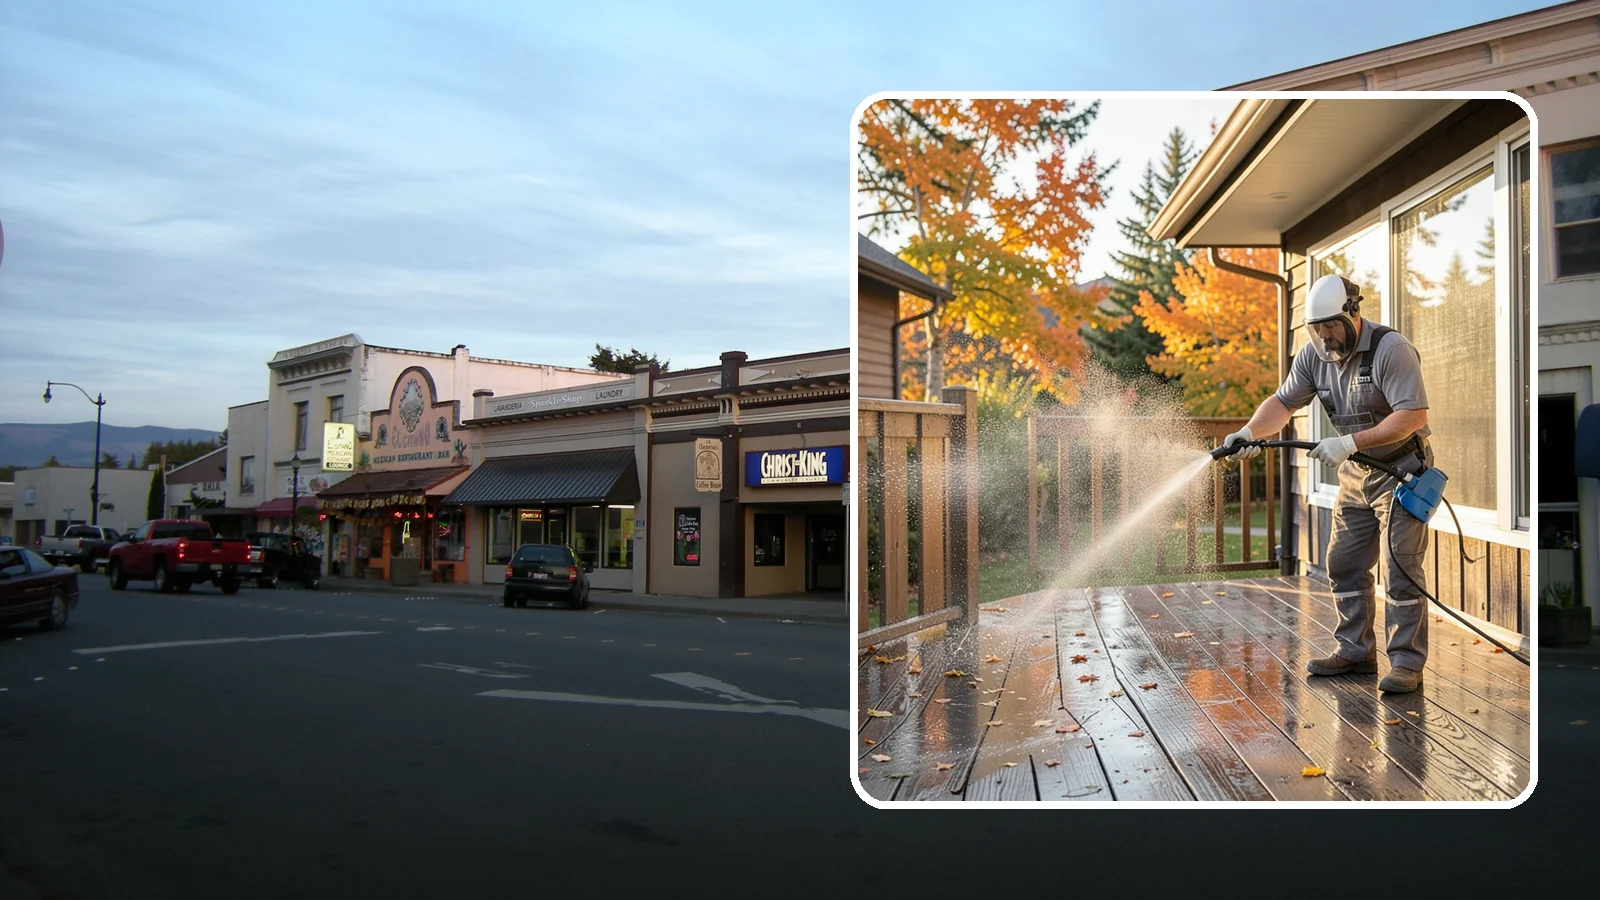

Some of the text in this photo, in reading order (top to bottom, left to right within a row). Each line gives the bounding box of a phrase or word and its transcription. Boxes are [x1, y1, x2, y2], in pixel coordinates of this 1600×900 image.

[596, 389, 623, 400] LAUNDRY
[494, 402, 523, 412] LAVANDERIA
[373, 450, 450, 464] MEXICAN RESTAURANT BAR
[761, 450, 827, 478] CHRIST KING
[697, 481, 722, 489] Coffee House
